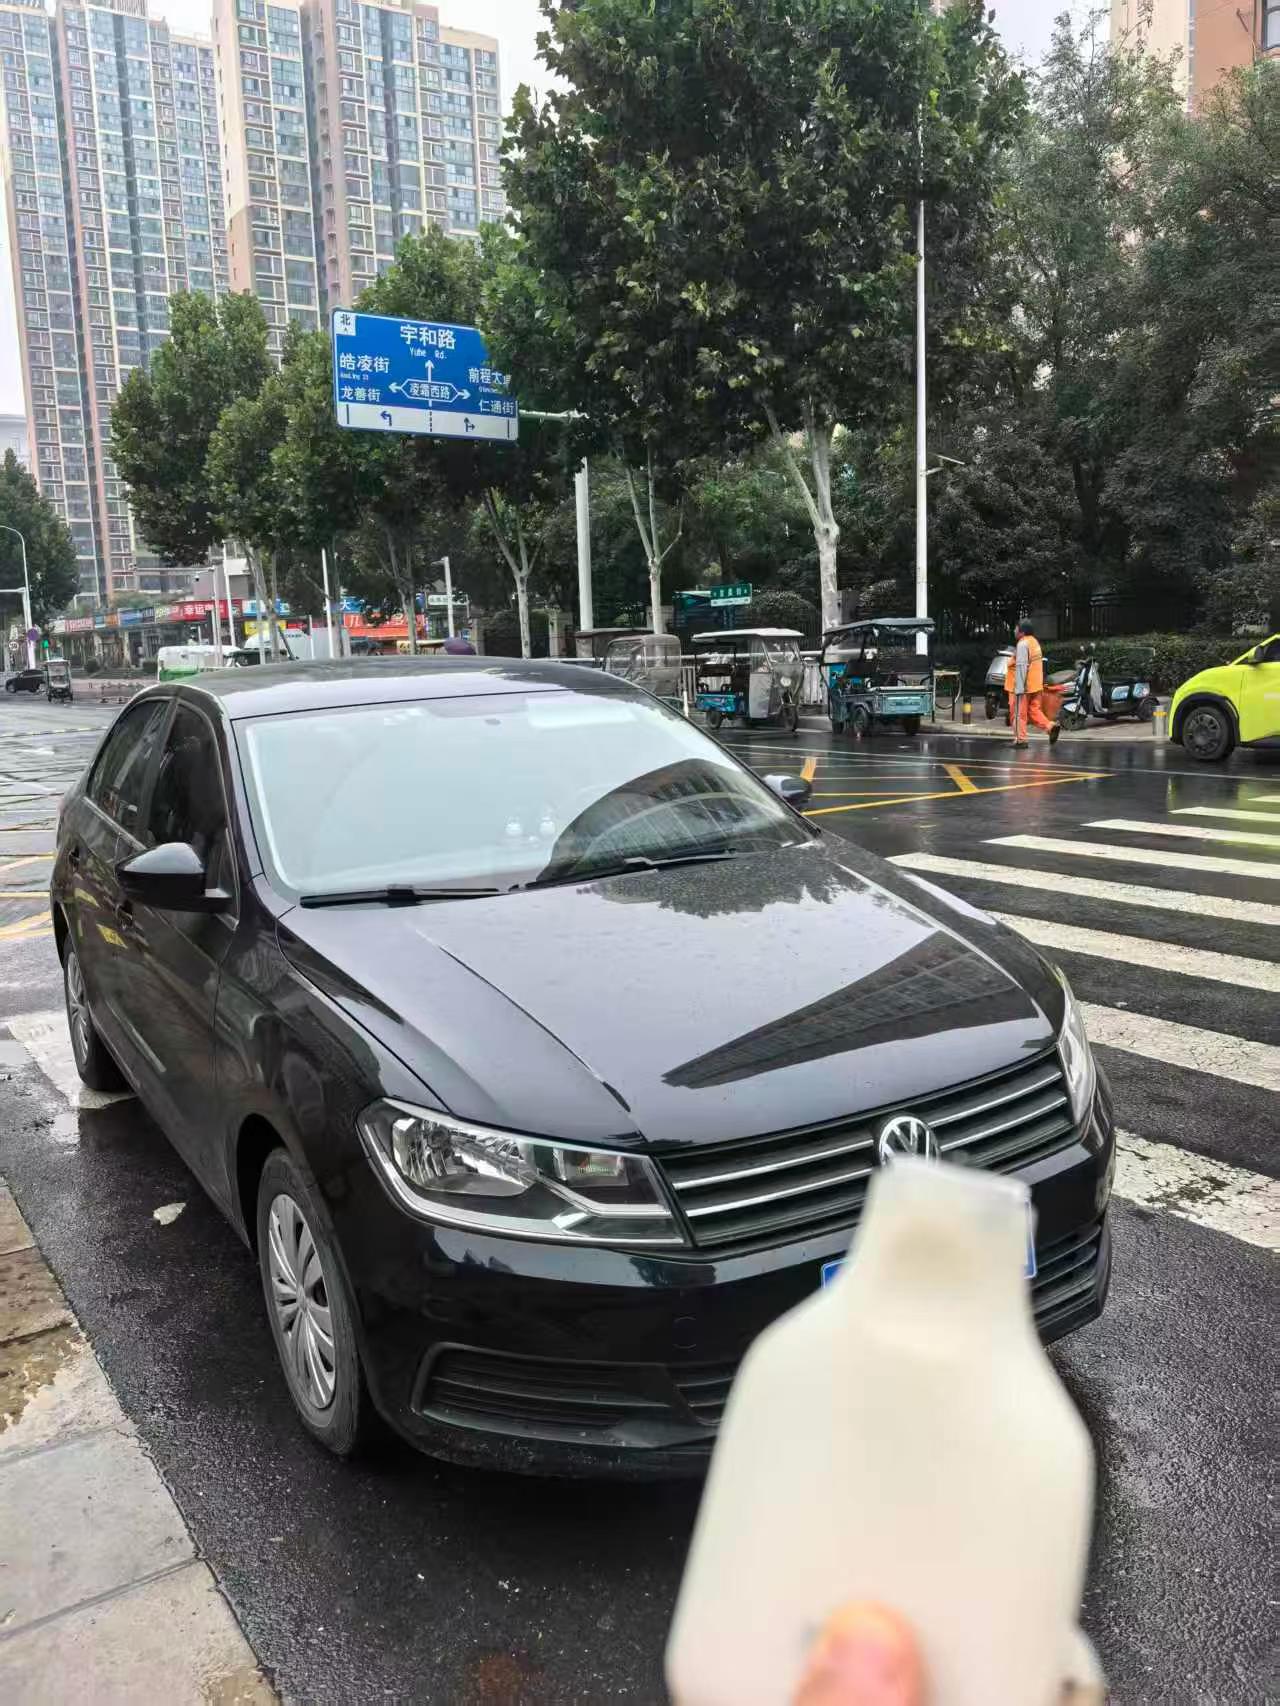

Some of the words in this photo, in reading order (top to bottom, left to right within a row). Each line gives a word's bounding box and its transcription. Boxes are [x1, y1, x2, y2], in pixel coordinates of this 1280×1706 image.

[340, 314, 351, 325] 北
[400, 324, 456, 350] 宇和路
[341, 386, 381, 402] 龙善街
[478, 399, 514, 415] 仁通街
